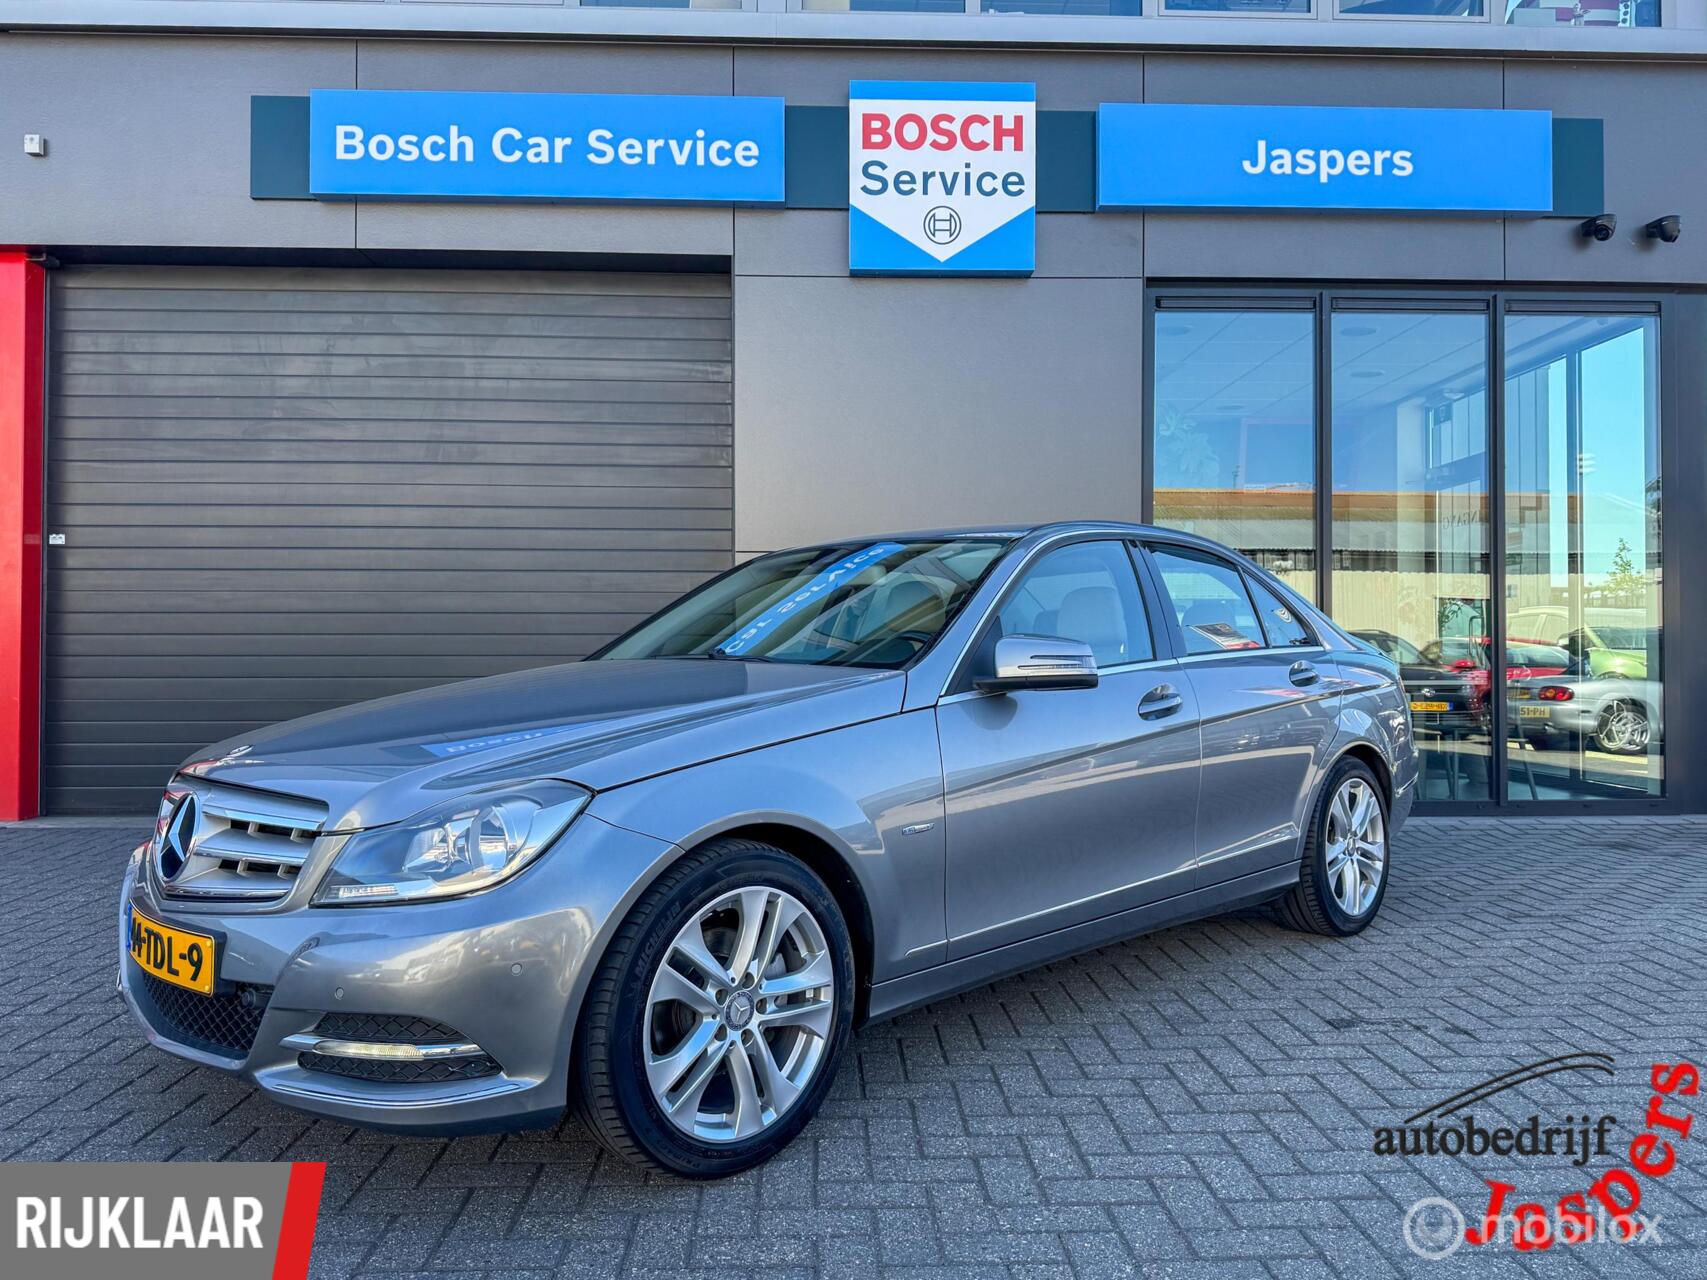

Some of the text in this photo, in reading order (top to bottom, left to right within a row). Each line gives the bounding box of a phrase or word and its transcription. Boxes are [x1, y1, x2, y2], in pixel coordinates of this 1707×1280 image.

[335, 125, 760, 168] Bosch Car Service
[861, 112, 1024, 152] BOSCH
[860, 159, 1026, 199] Service
[1242, 139, 1414, 183] Jaspers
